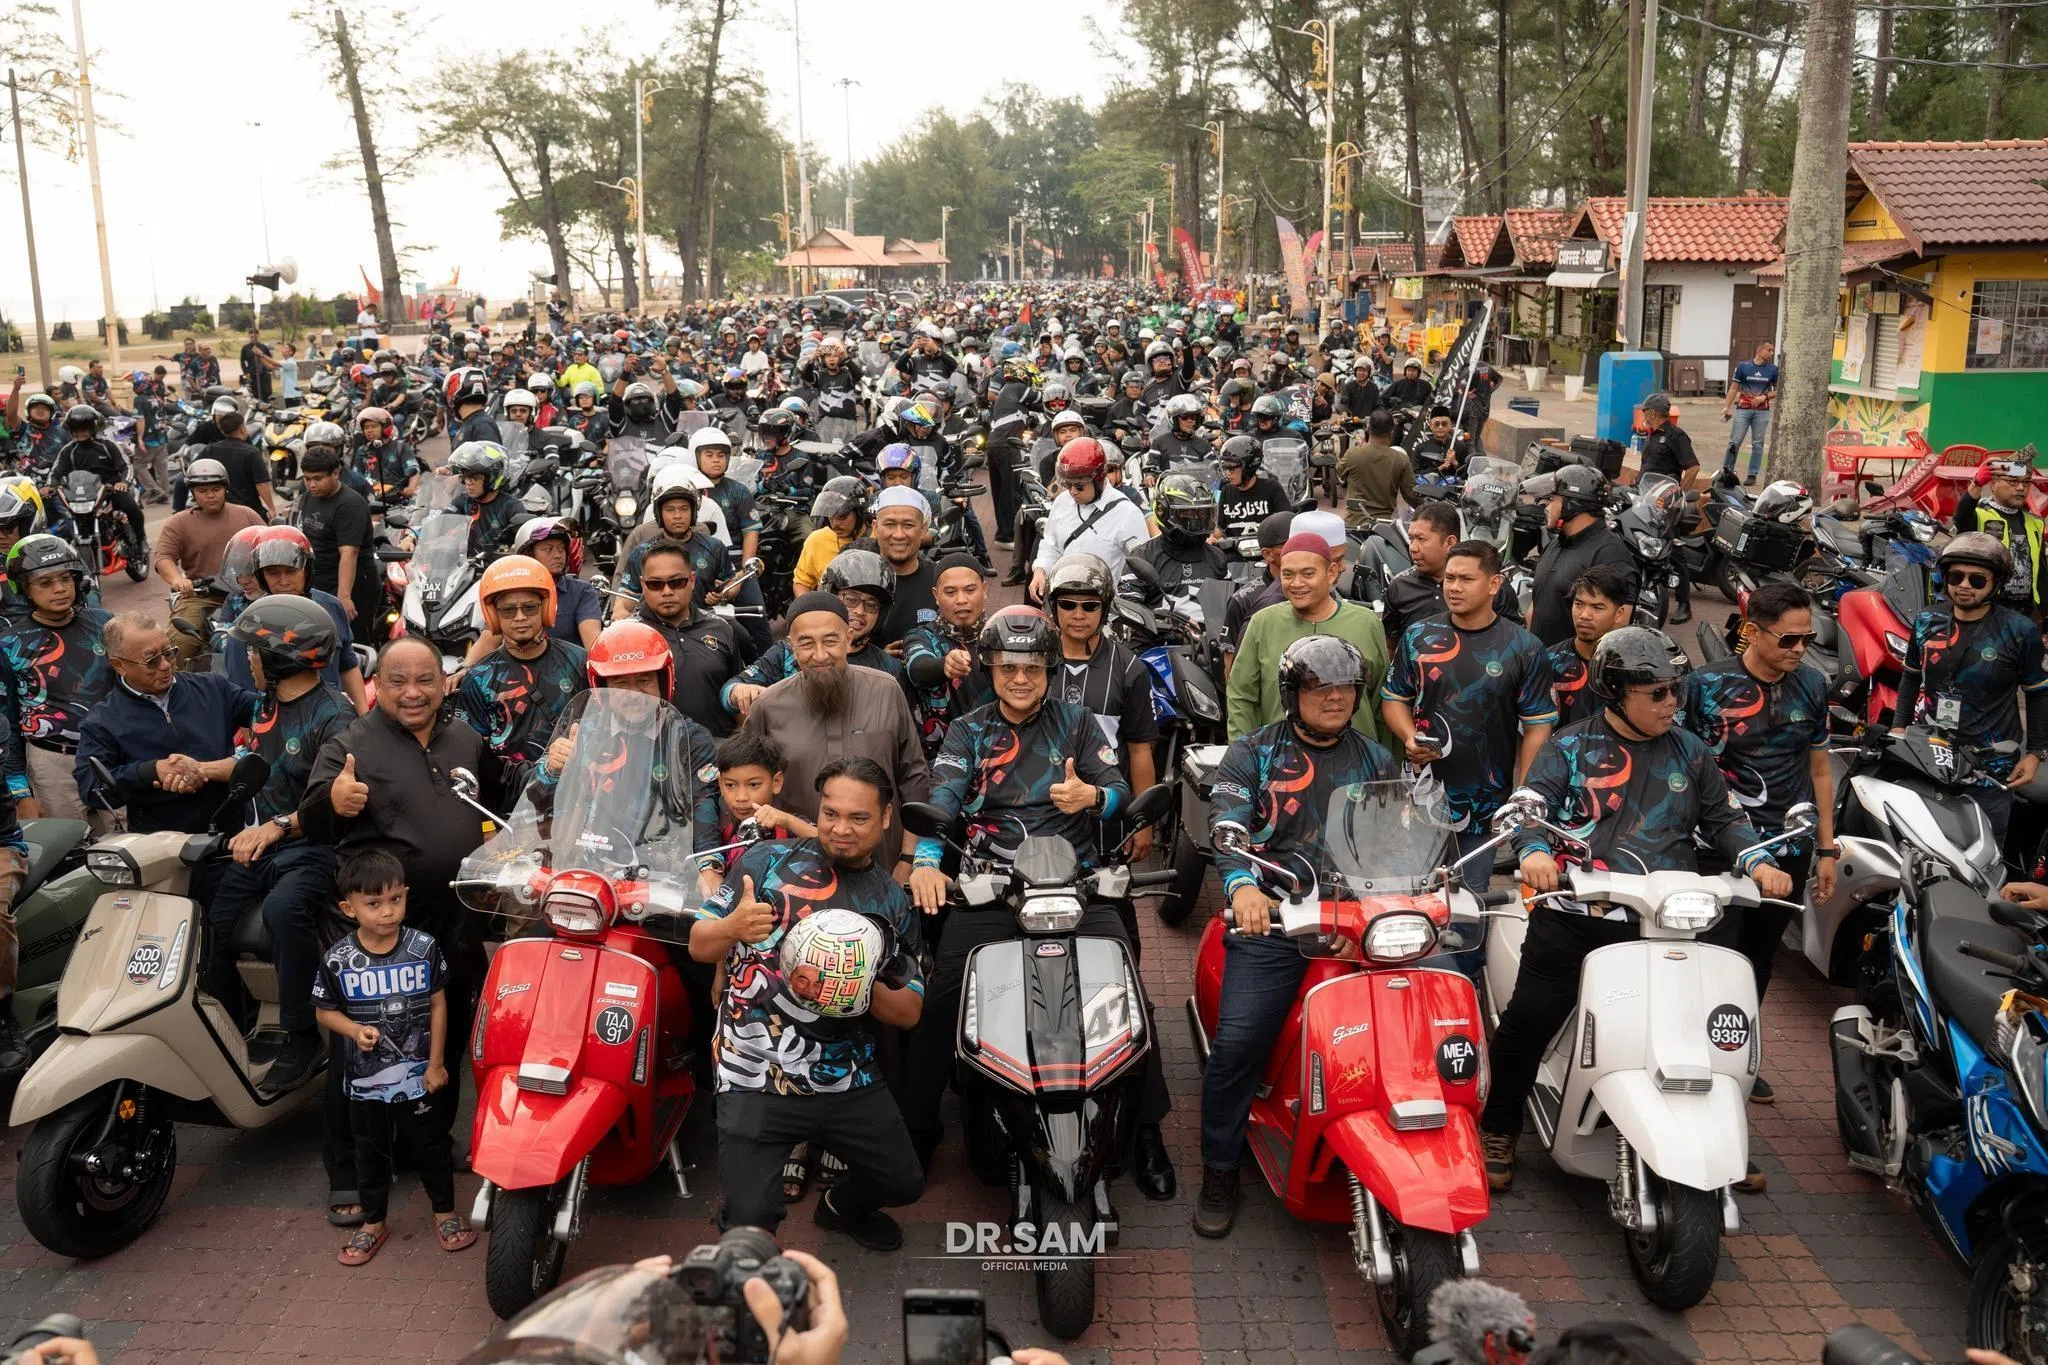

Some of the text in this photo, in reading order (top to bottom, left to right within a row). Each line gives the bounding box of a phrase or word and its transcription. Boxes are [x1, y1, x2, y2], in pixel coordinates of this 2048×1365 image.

[1558, 249, 1603, 265] COFFEE SHOP
[1223, 500, 1269, 519] الأناركية
[40, 552, 64, 563] SGV
[1006, 636, 1037, 644] SGV
[134, 948, 160, 961] QDD
[128, 962, 160, 975] 6002
[343, 964, 426, 997] POLICE
[312, 985, 326, 998] ICE
[605, 1010, 628, 1030] TAA
[1085, 992, 1129, 1039] 47
[1712, 1013, 1743, 1029] JXN
[606, 1027, 622, 1043] 91
[1332, 1022, 1369, 1045] G350
[1711, 1028, 1747, 1045] 9387
[1442, 1041, 1474, 1060] MEA
[1451, 1058, 1465, 1074] 17
